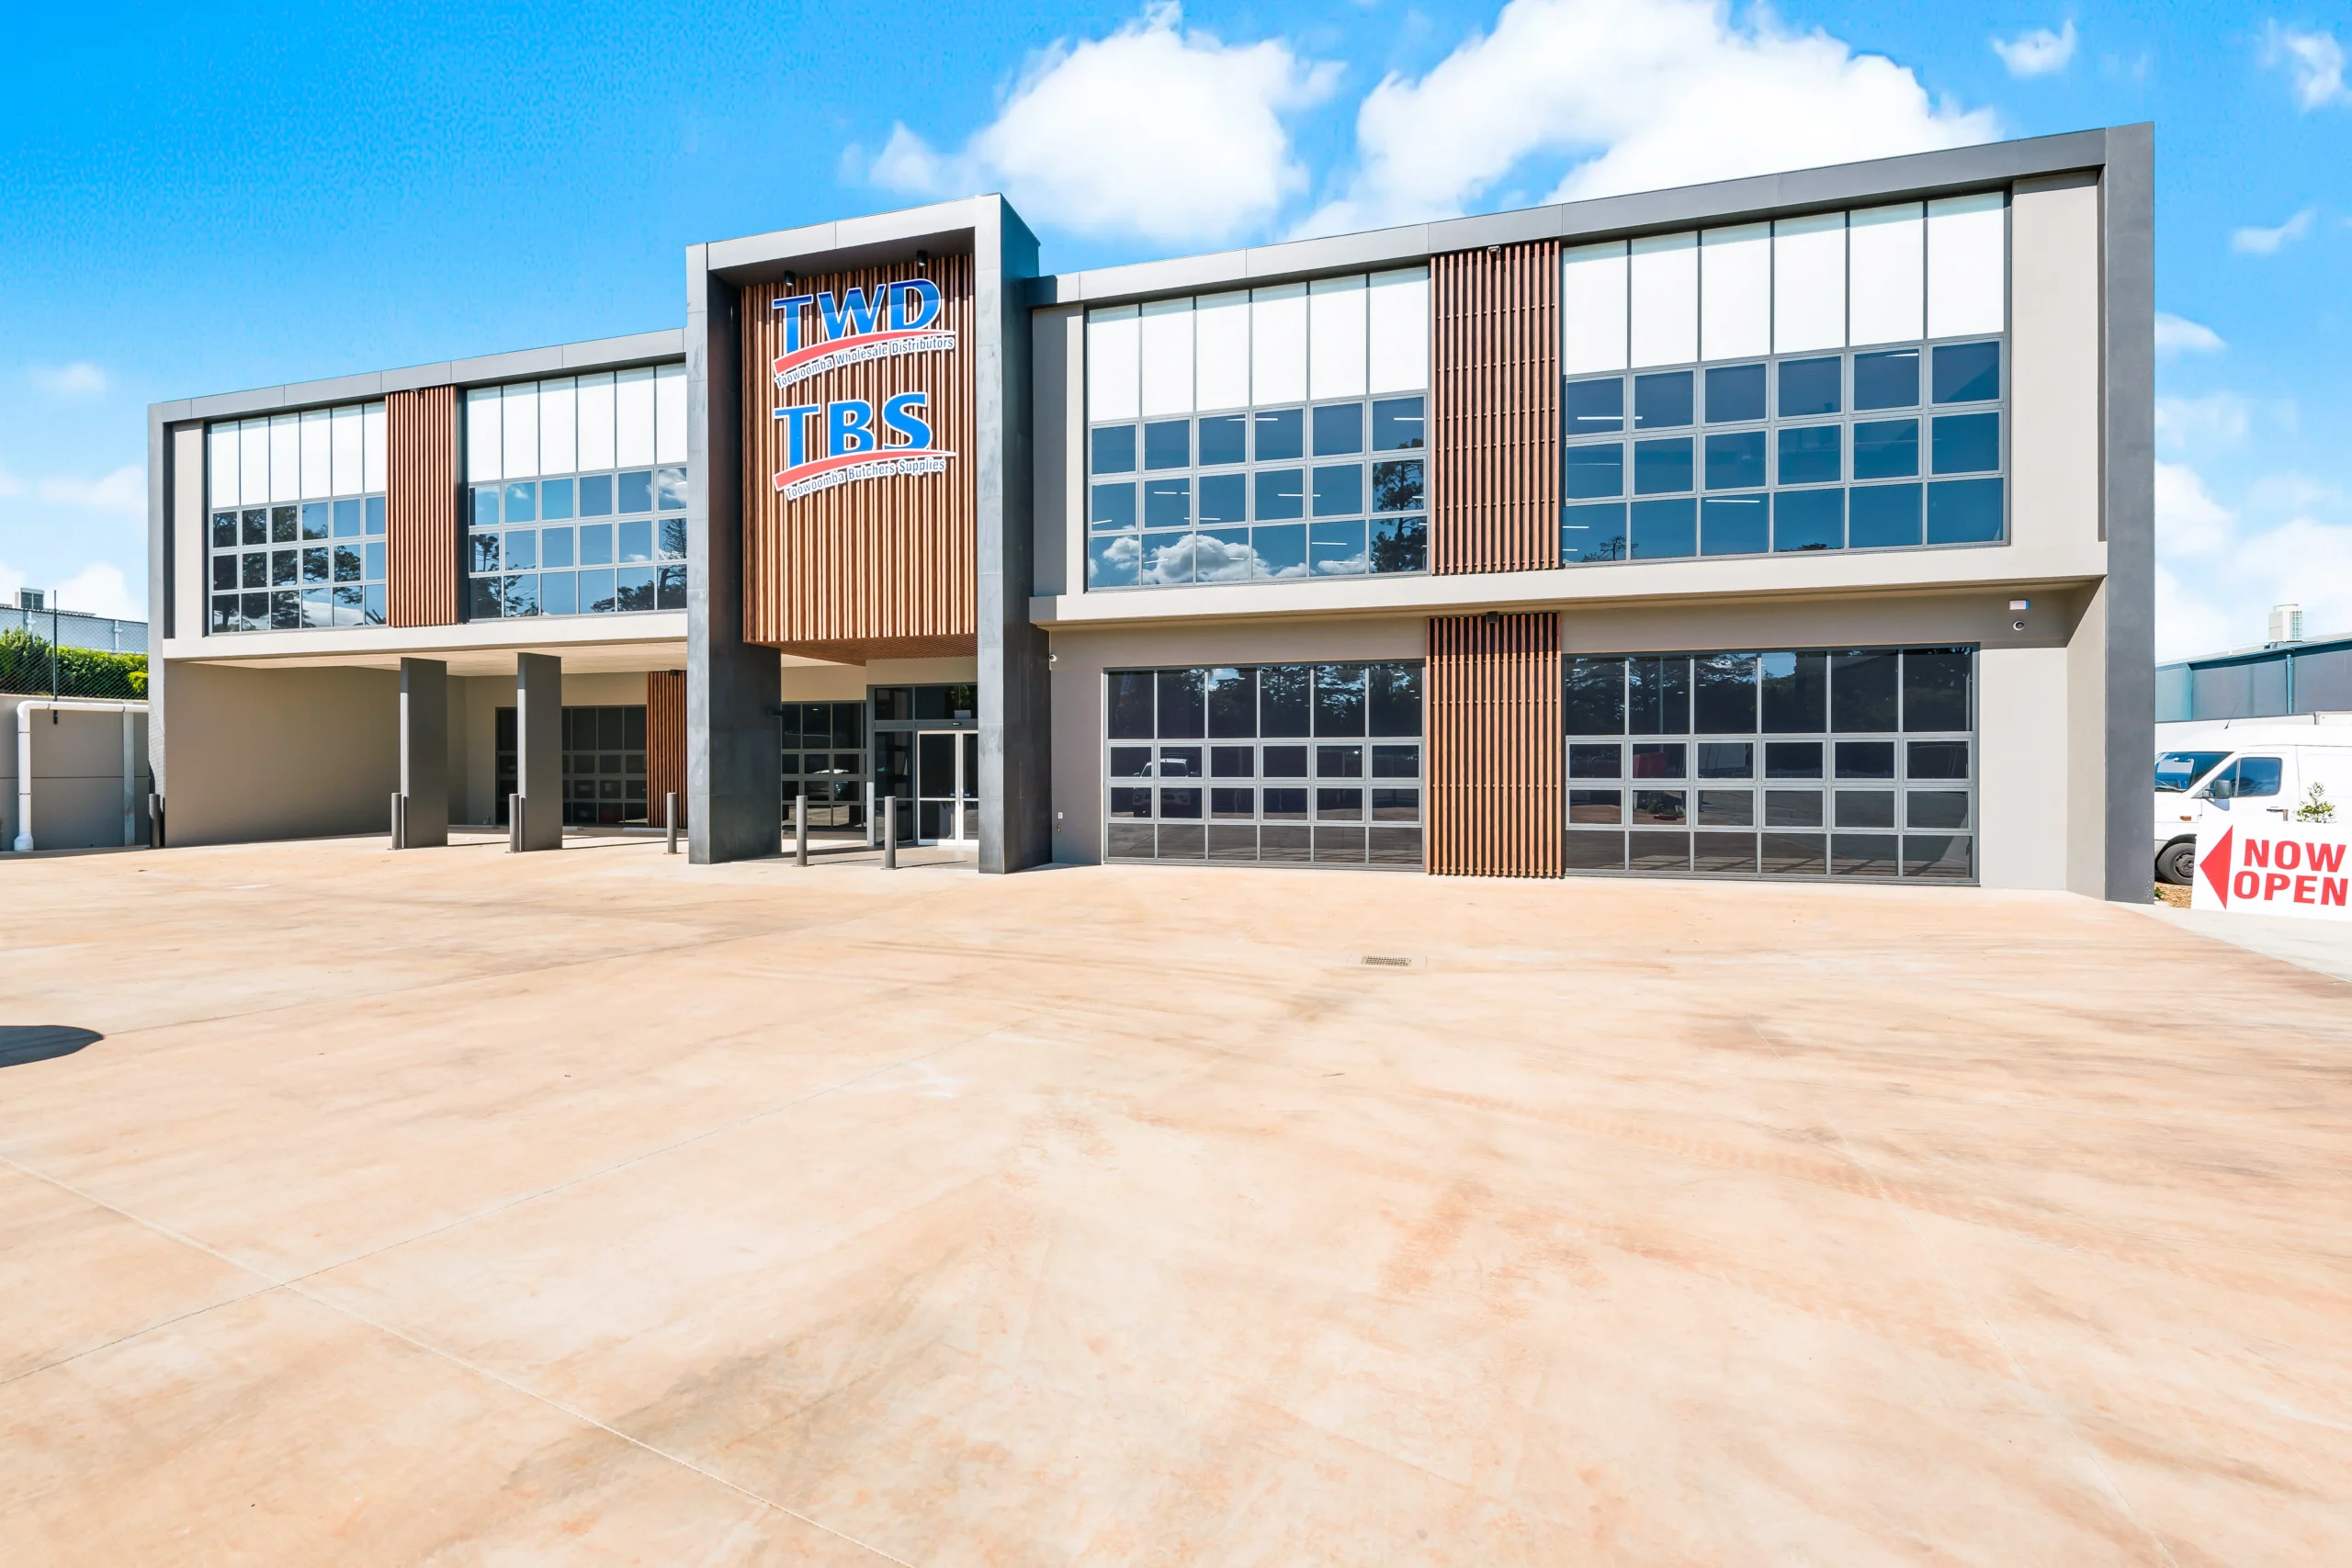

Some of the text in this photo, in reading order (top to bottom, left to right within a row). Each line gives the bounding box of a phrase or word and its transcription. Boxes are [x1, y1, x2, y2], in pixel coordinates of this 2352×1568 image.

[773, 278, 941, 355] TWD
[775, 336, 954, 388] Toowoomba Wholesale Distributors
[774, 392, 933, 468] TBS
[786, 457, 945, 500] Toowoomba Butchers Supplies
[2244, 839, 2346, 873] NOW
[2233, 870, 2348, 907] OPEN
